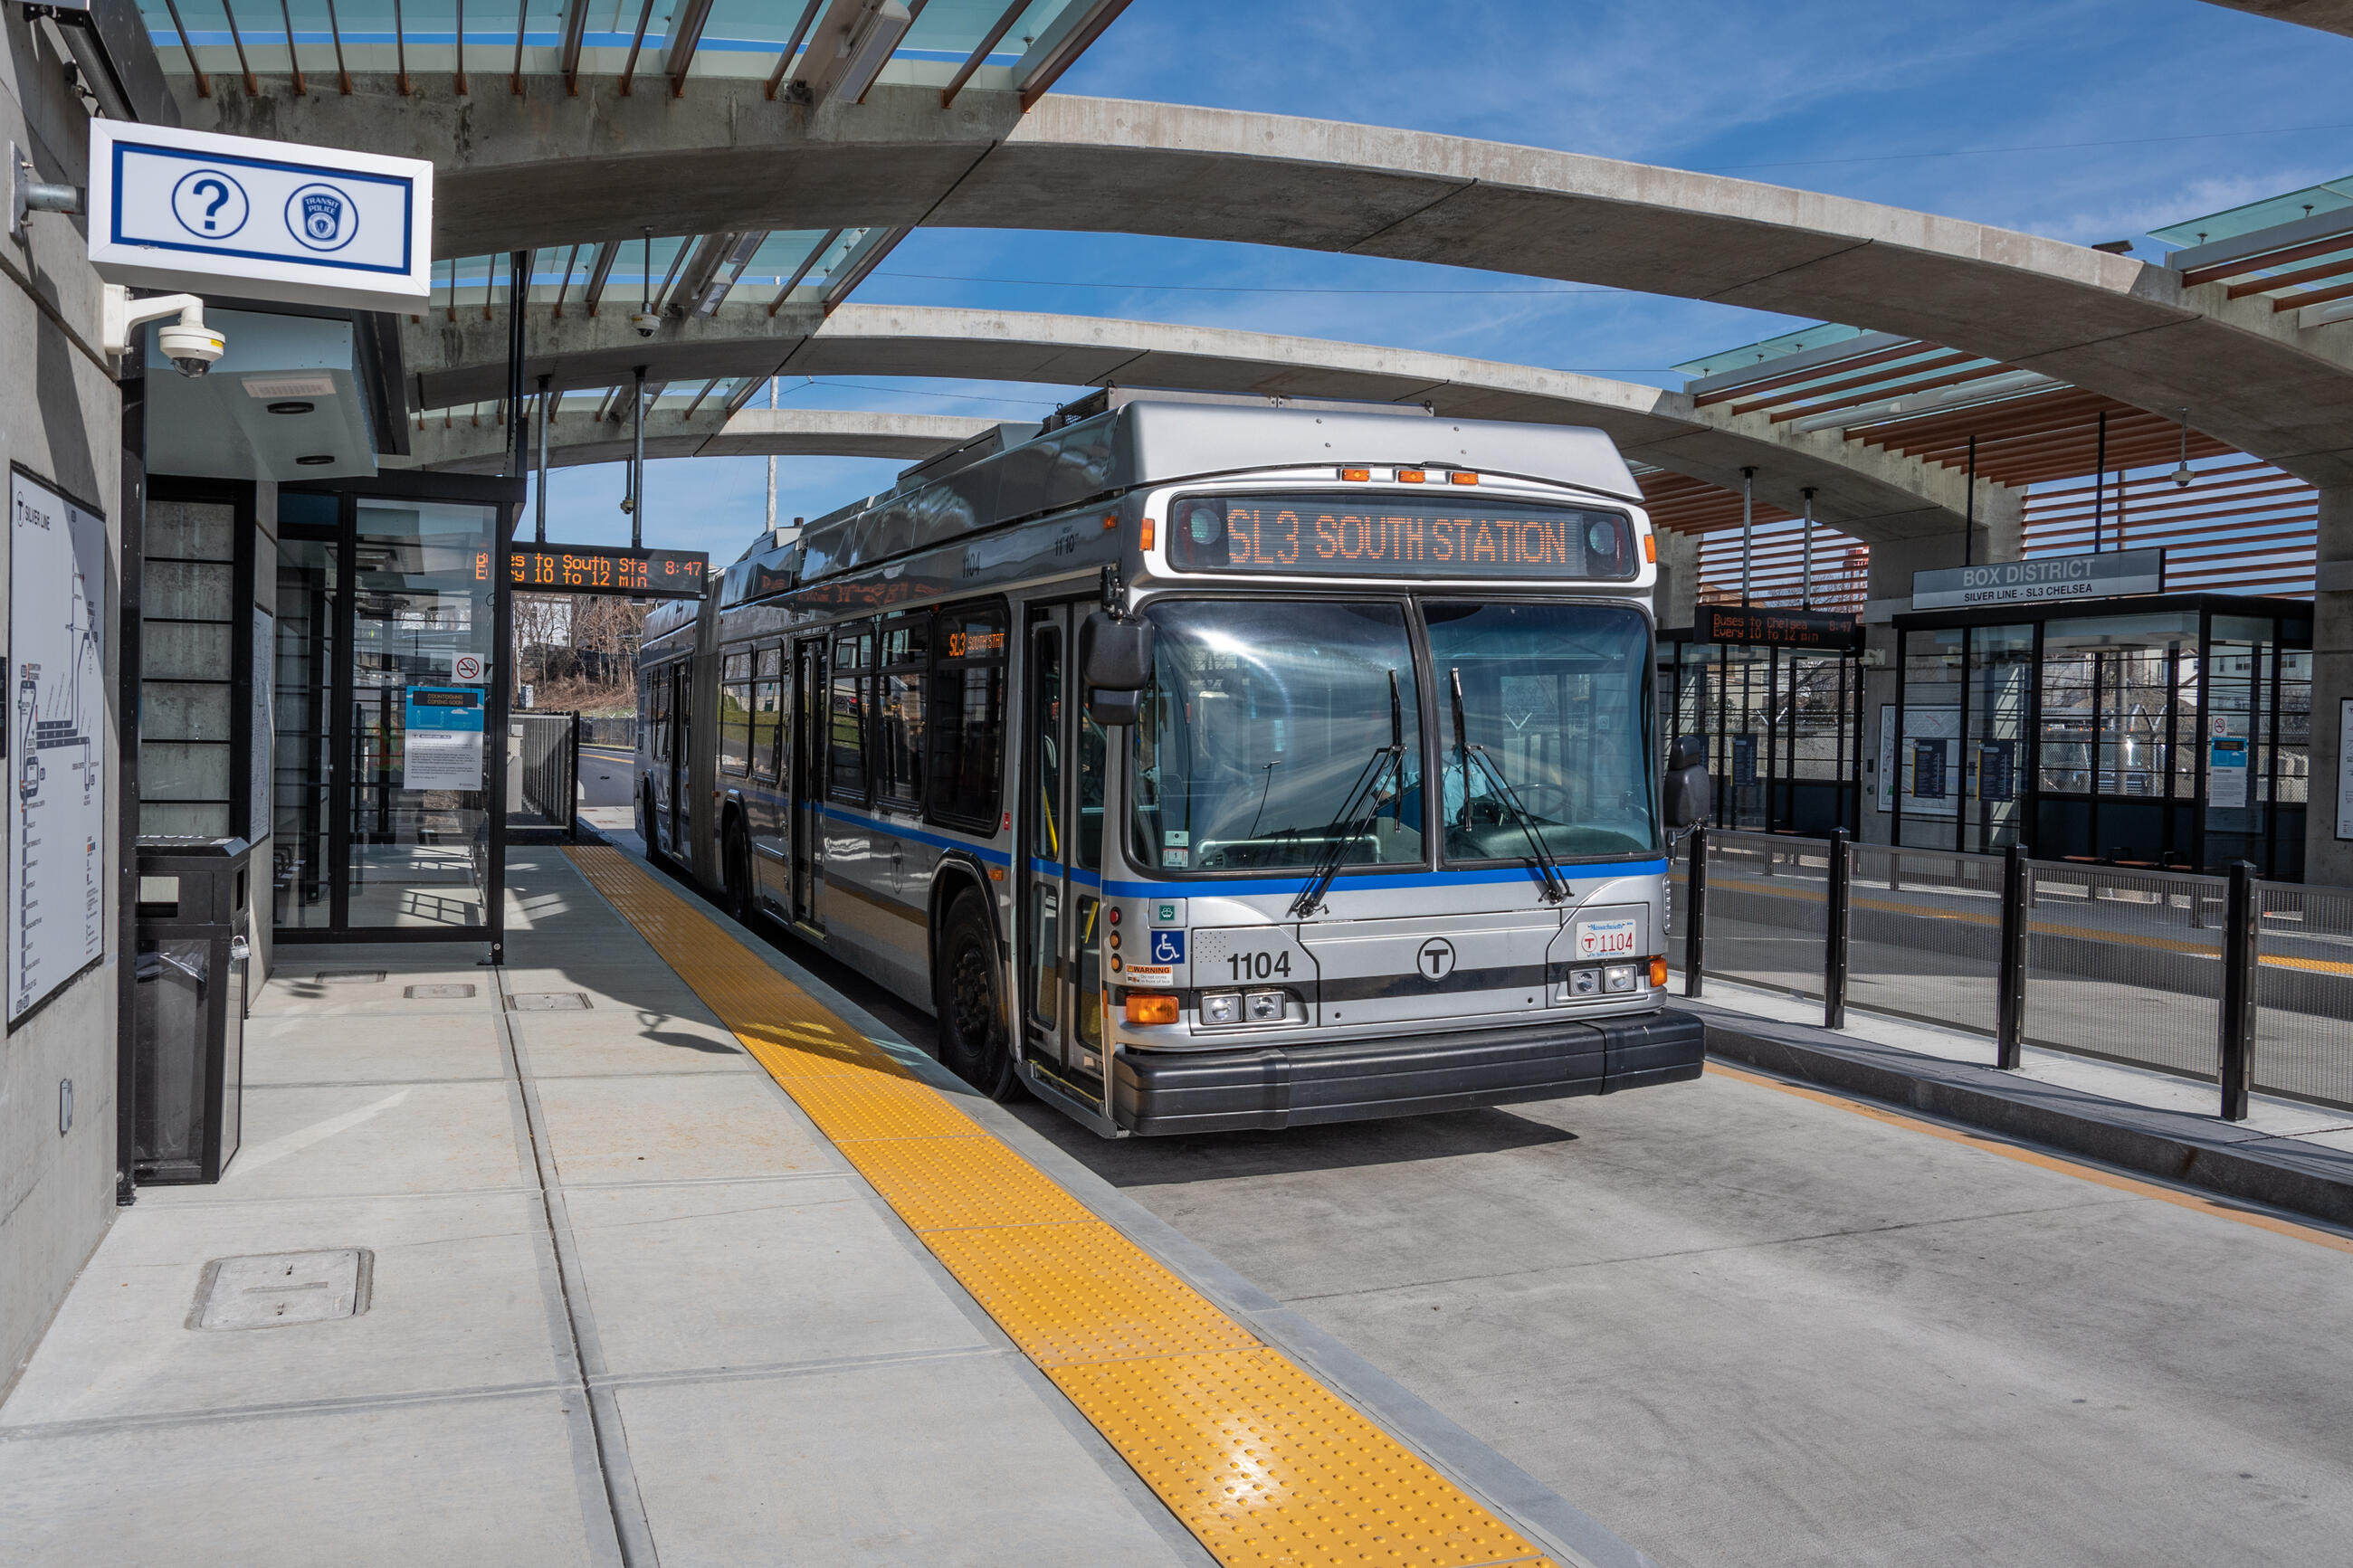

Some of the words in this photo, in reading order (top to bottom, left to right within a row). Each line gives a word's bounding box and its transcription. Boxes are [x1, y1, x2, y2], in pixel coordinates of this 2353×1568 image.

[304, 196, 339, 209] TRANSIT
[308, 204, 336, 215] POLICE
[1227, 508, 1299, 564] SL3
[1316, 515, 1424, 560] SOUTH
[1433, 518, 1566, 564] STATION
[535, 553, 554, 569] to
[562, 555, 611, 572] South
[618, 557, 647, 575] Sta
[665, 561, 702, 576] 8:47
[962, 551, 981, 578] 1104
[1963, 567, 2001, 587] BOX
[2005, 559, 2096, 584] DISTRICT
[535, 568, 554, 584] 10
[562, 569, 582, 584] to
[592, 570, 610, 586] 12
[618, 573, 647, 588] min
[1964, 590, 1995, 603] SILVER
[1996, 589, 2017, 600] LINE
[2025, 587, 2043, 597] SL3
[2045, 584, 2092, 596] CHELSEA
[1713, 613, 1745, 627] Buses
[1748, 615, 1762, 627] to
[1766, 616, 1808, 630] Chelsea
[1829, 620, 1853, 633] 8:47
[1713, 624, 1744, 638] Every
[1749, 627, 1762, 640] 10
[1767, 630, 1779, 641] to
[1784, 631, 1796, 641] 12
[1800, 632, 1819, 642] min
[948, 632, 967, 657] SL3
[967, 635, 986, 651] SOUTH
[1589, 923, 1624, 931] Massachusetts
[1599, 932, 1633, 953] 1104
[1226, 950, 1291, 981] 1104
[1424, 948, 1449, 974] T
